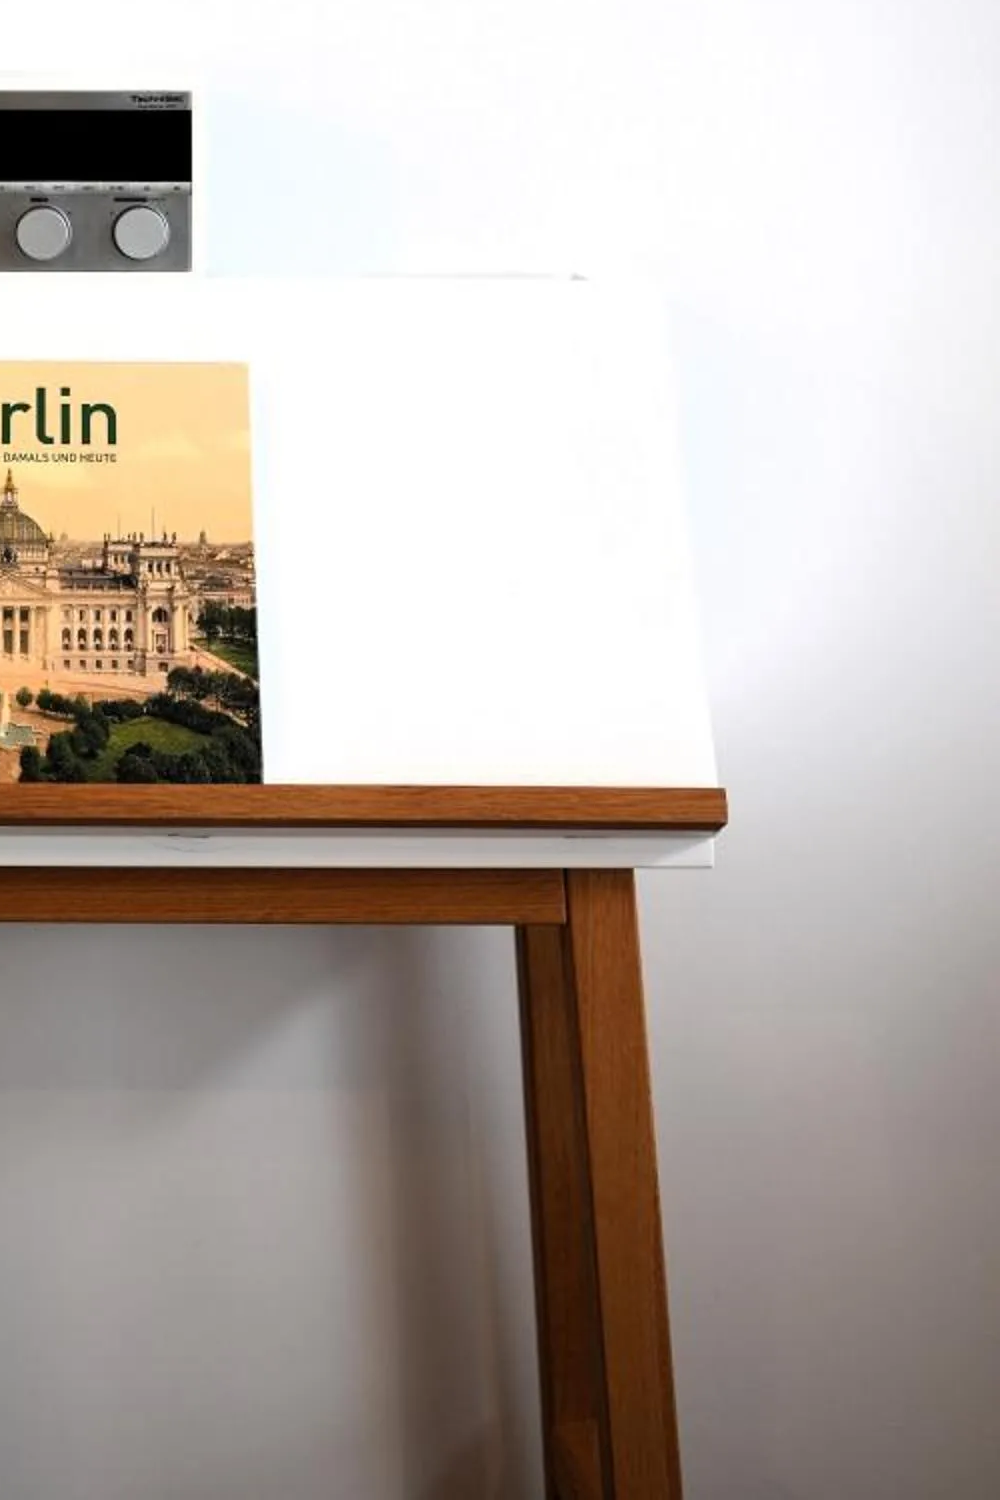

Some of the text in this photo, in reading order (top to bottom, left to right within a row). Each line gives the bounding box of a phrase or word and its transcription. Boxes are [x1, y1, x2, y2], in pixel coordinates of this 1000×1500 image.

[3, 453, 49, 463] DAMALS
[52, 453, 76, 463] UND
[80, 453, 117, 463] HEUTE
